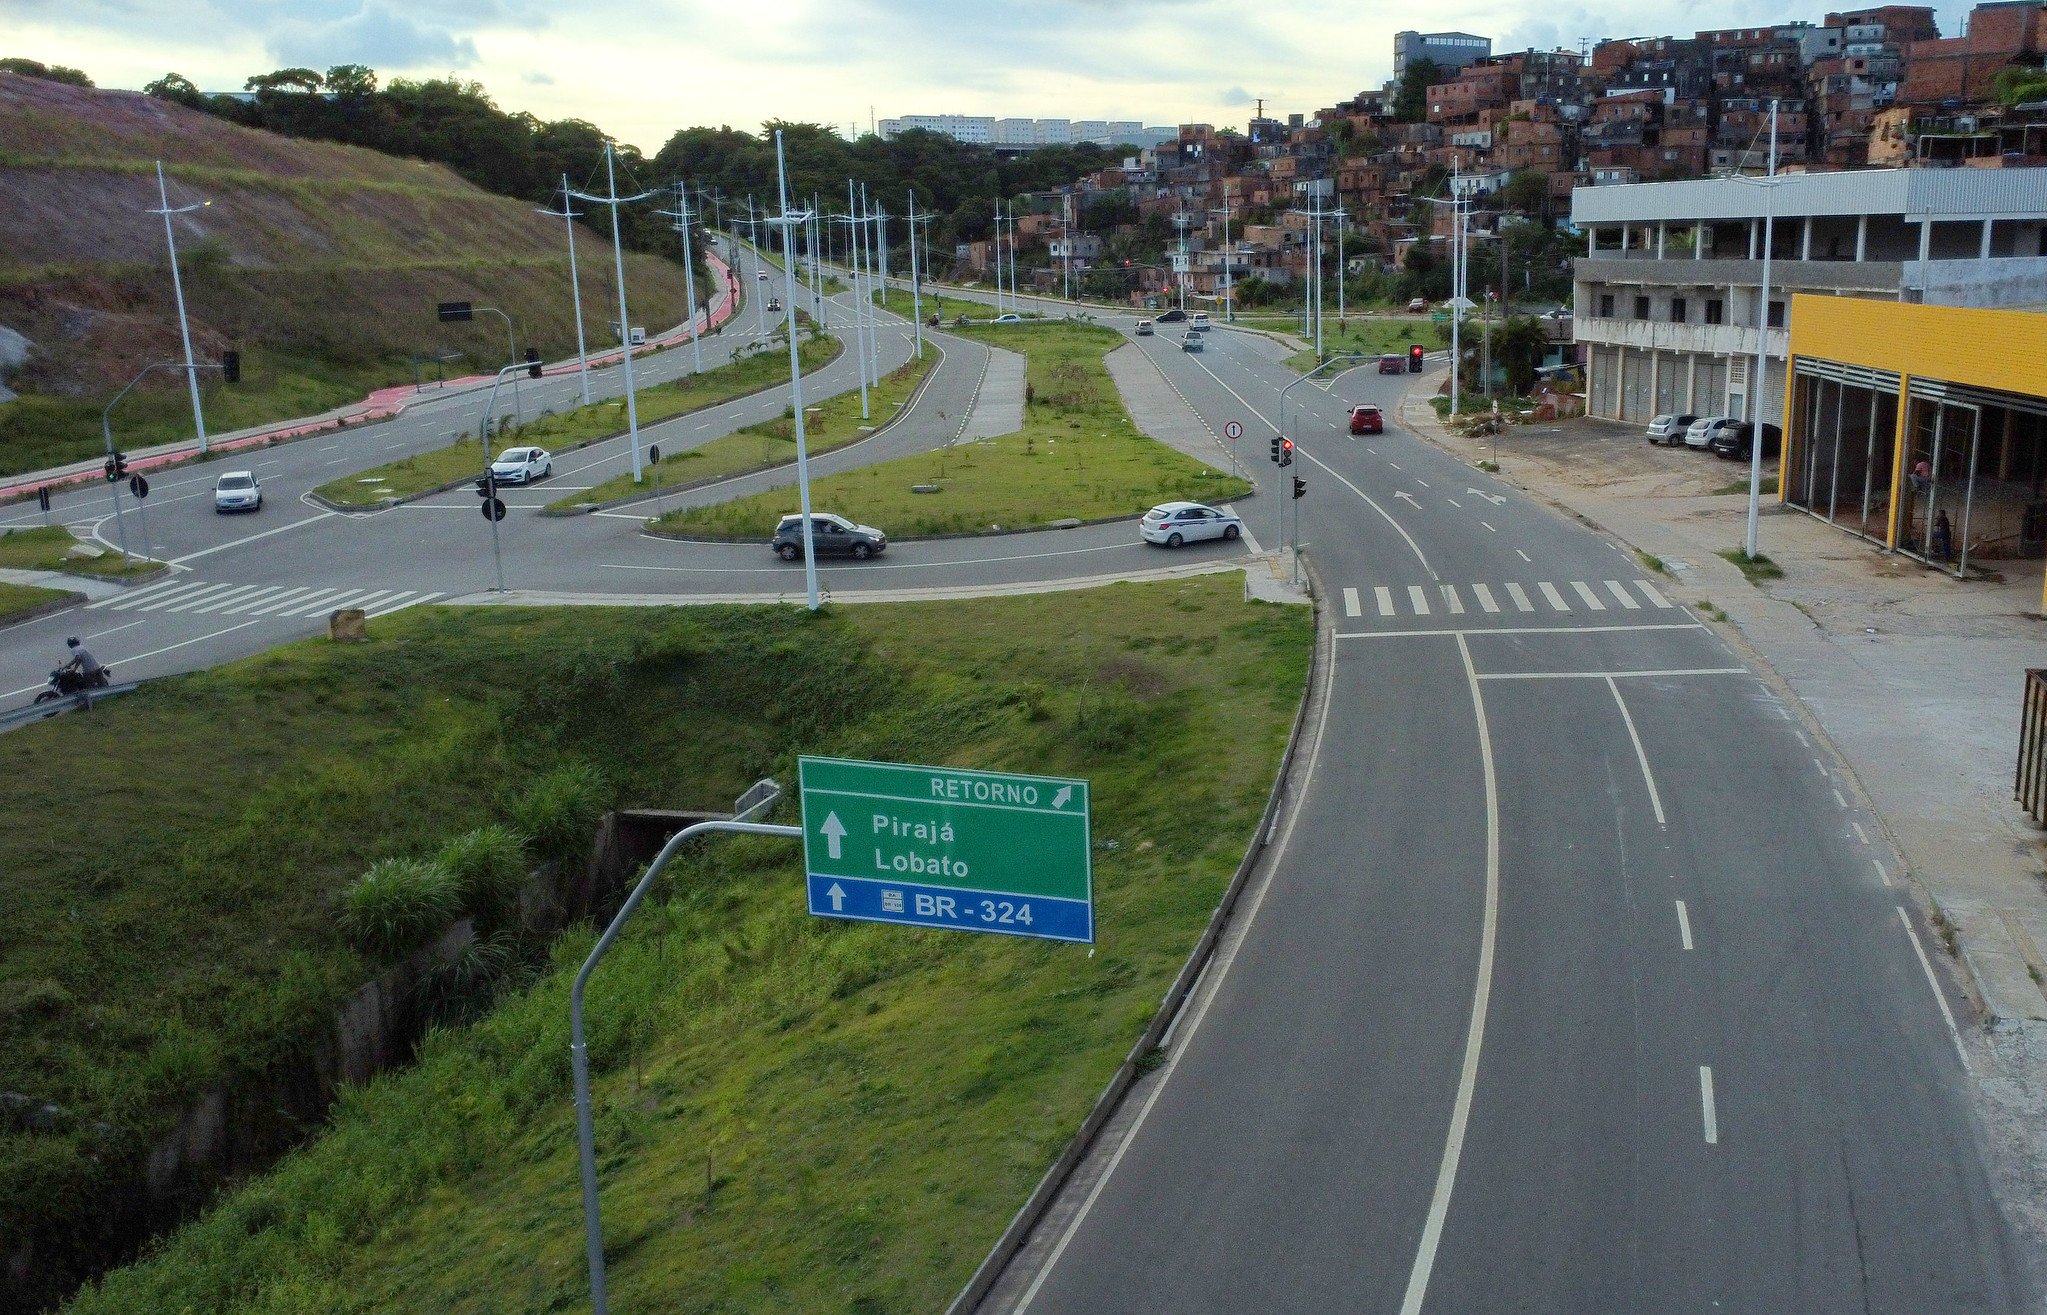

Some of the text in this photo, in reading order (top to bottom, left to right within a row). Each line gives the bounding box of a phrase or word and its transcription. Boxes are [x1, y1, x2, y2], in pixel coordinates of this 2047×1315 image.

[930, 777, 1039, 805] RETORNO
[872, 814, 955, 845] Pirajá
[875, 848, 969, 878] Lobato
[915, 893, 958, 919] BR
[980, 899, 1033, 926] 324
